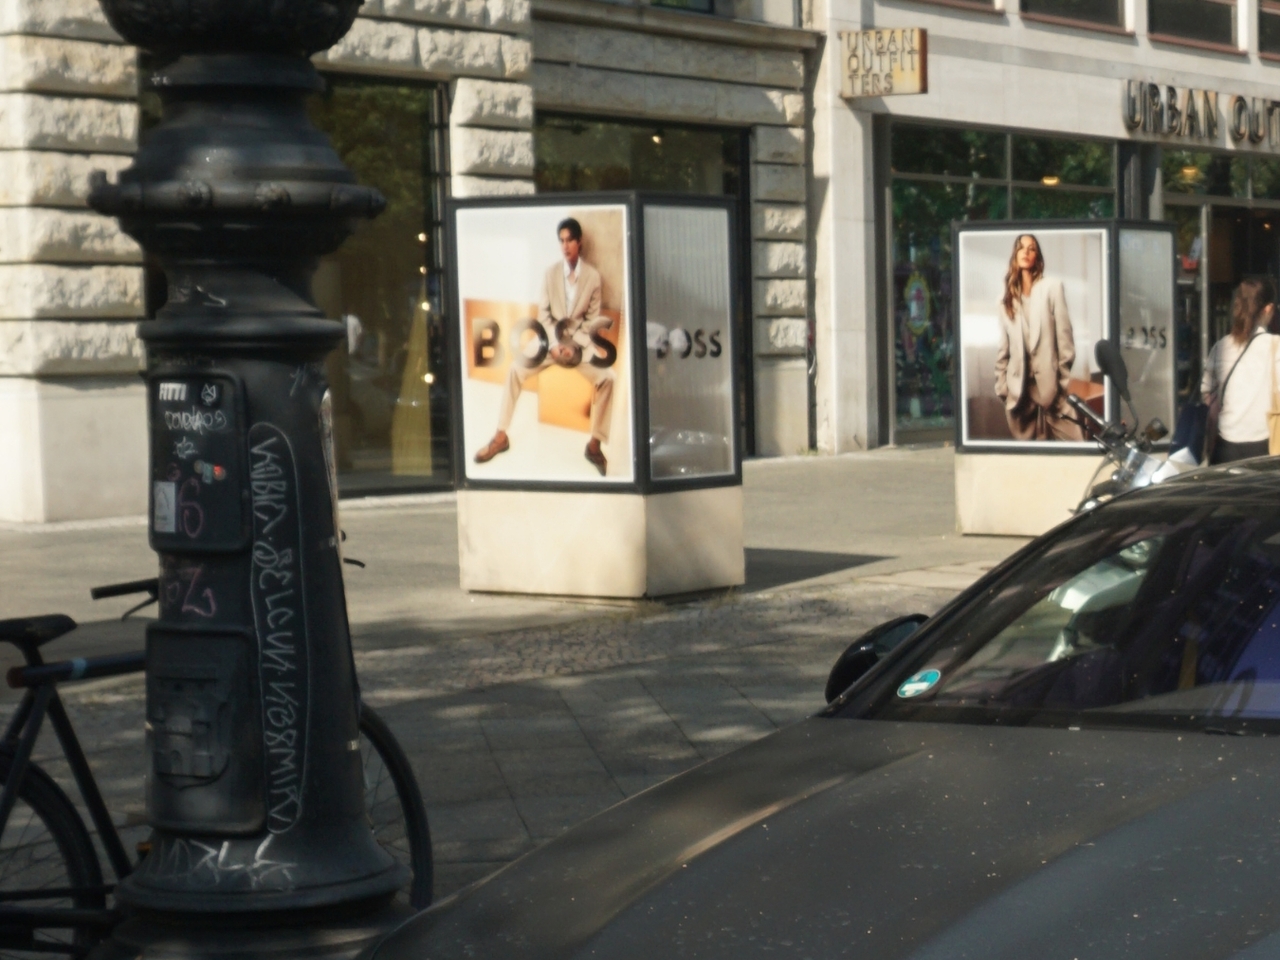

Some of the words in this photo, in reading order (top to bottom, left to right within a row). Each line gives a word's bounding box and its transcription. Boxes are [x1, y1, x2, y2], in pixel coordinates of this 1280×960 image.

[847, 28, 916, 53] URBAN
[848, 49, 920, 73] OUTFIT
[848, 73, 893, 95] TERS
[1122, 79, 1219, 138] URBAN
[472, 315, 618, 369] BOSS
